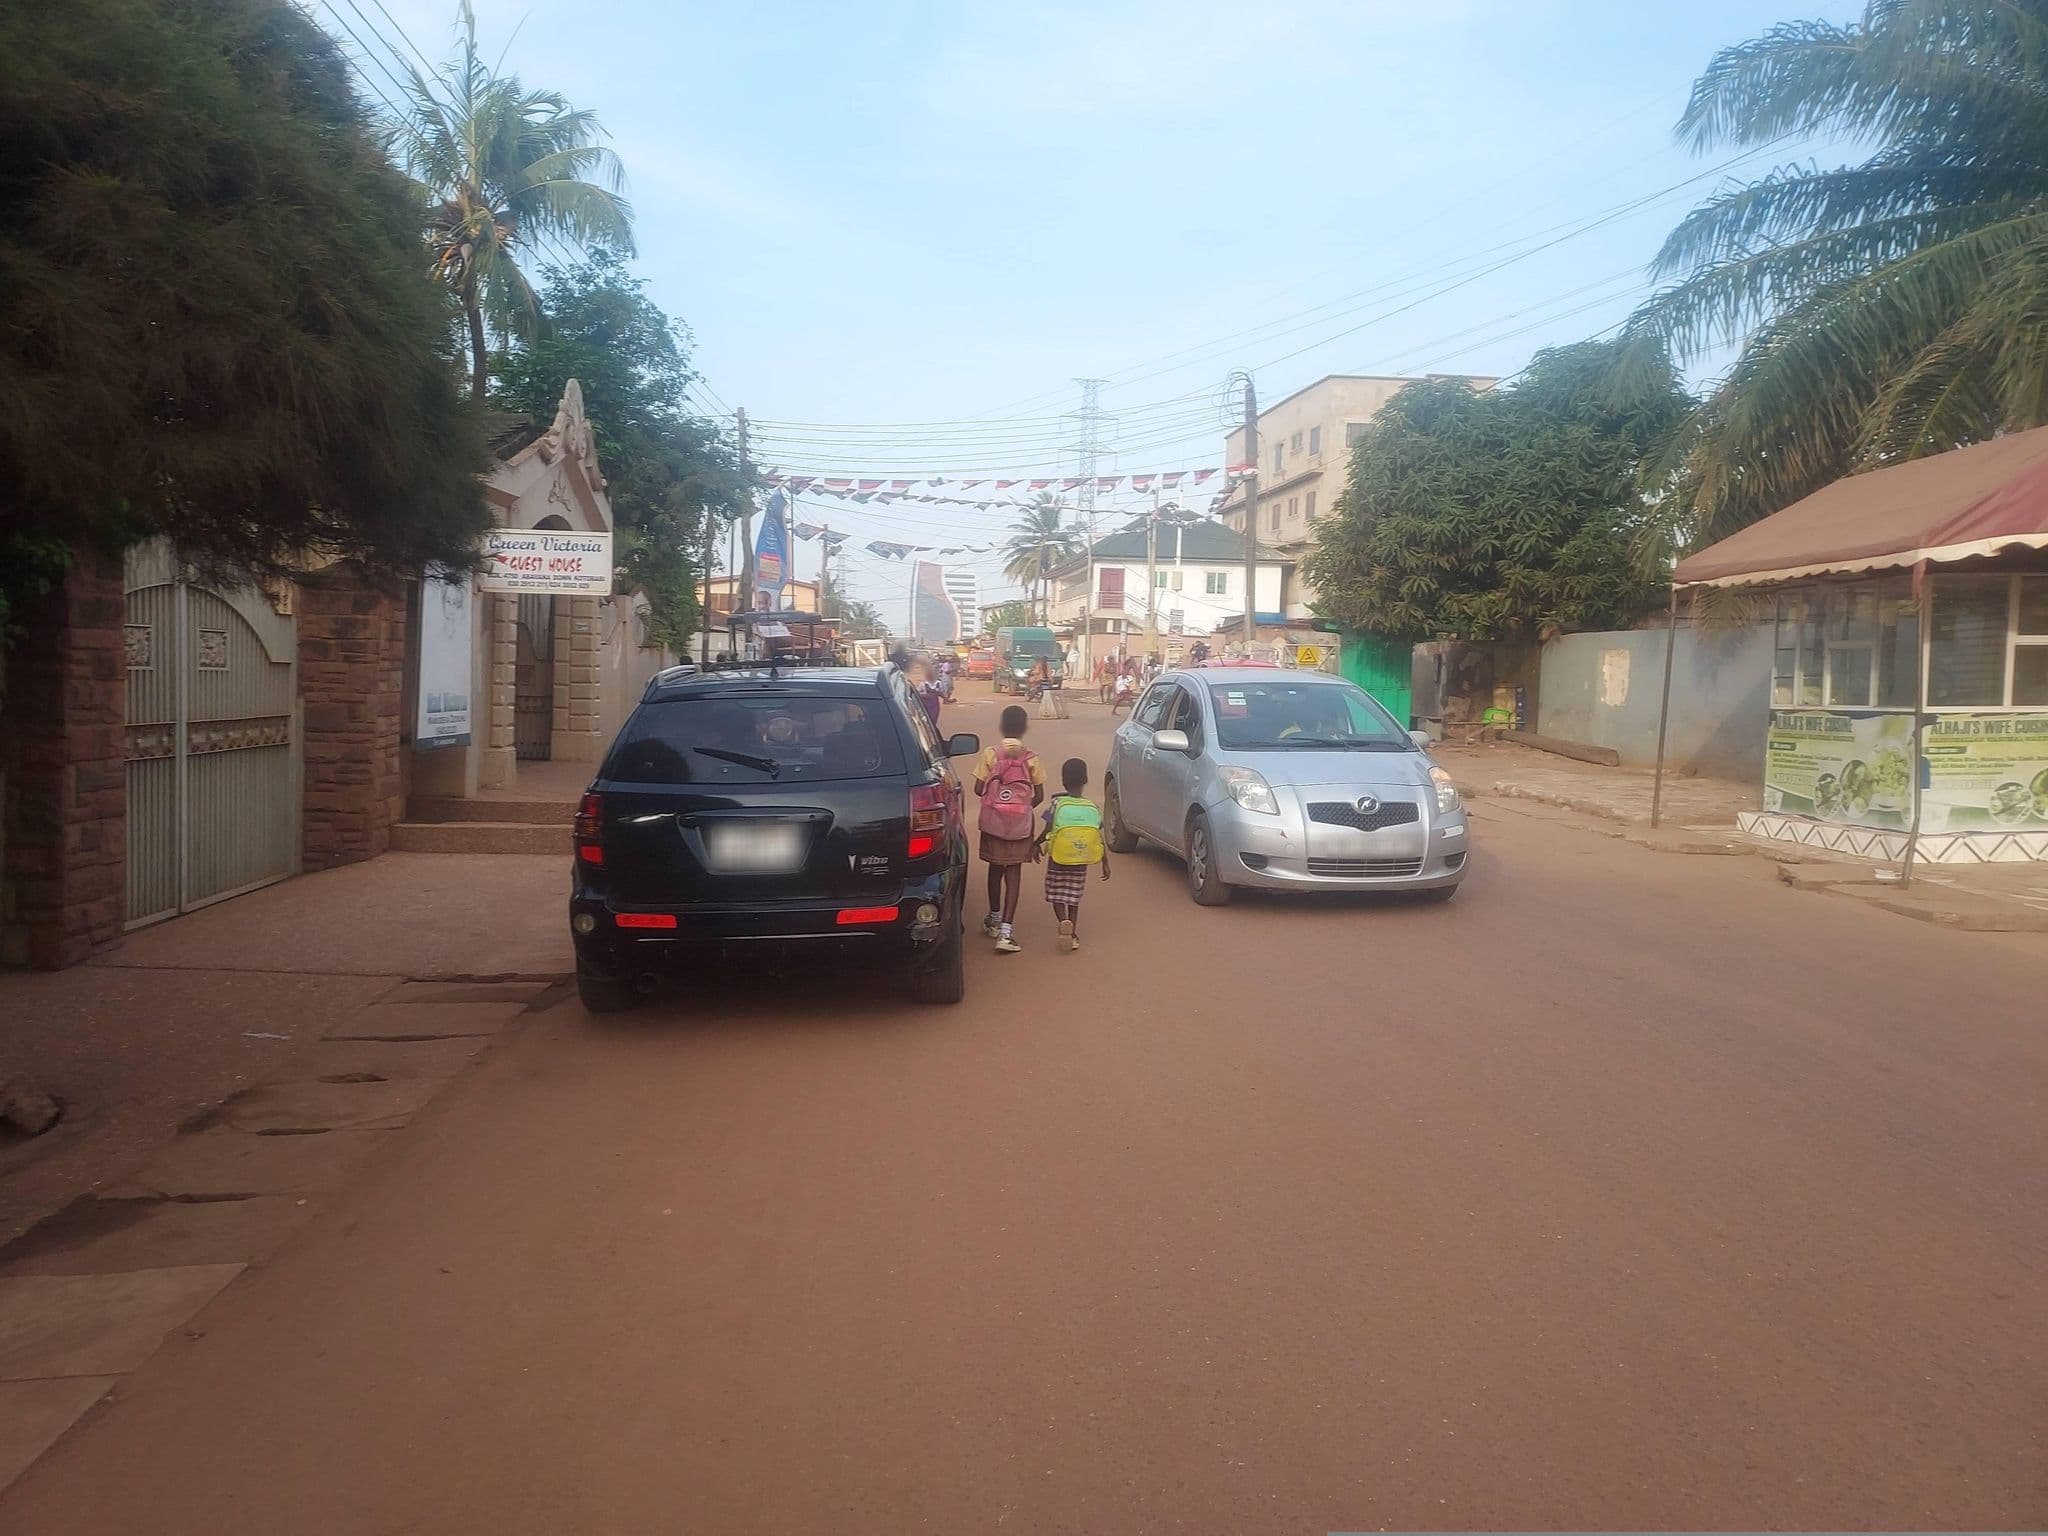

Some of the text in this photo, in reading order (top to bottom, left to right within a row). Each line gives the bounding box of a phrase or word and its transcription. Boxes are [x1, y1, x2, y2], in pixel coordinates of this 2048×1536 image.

[489, 534, 602, 552] Queen Victoria
[510, 556, 582, 572] GUEST HOUSE
[1930, 720, 1980, 735] ALHAJI'S
[1984, 719, 2012, 734] WIFE
